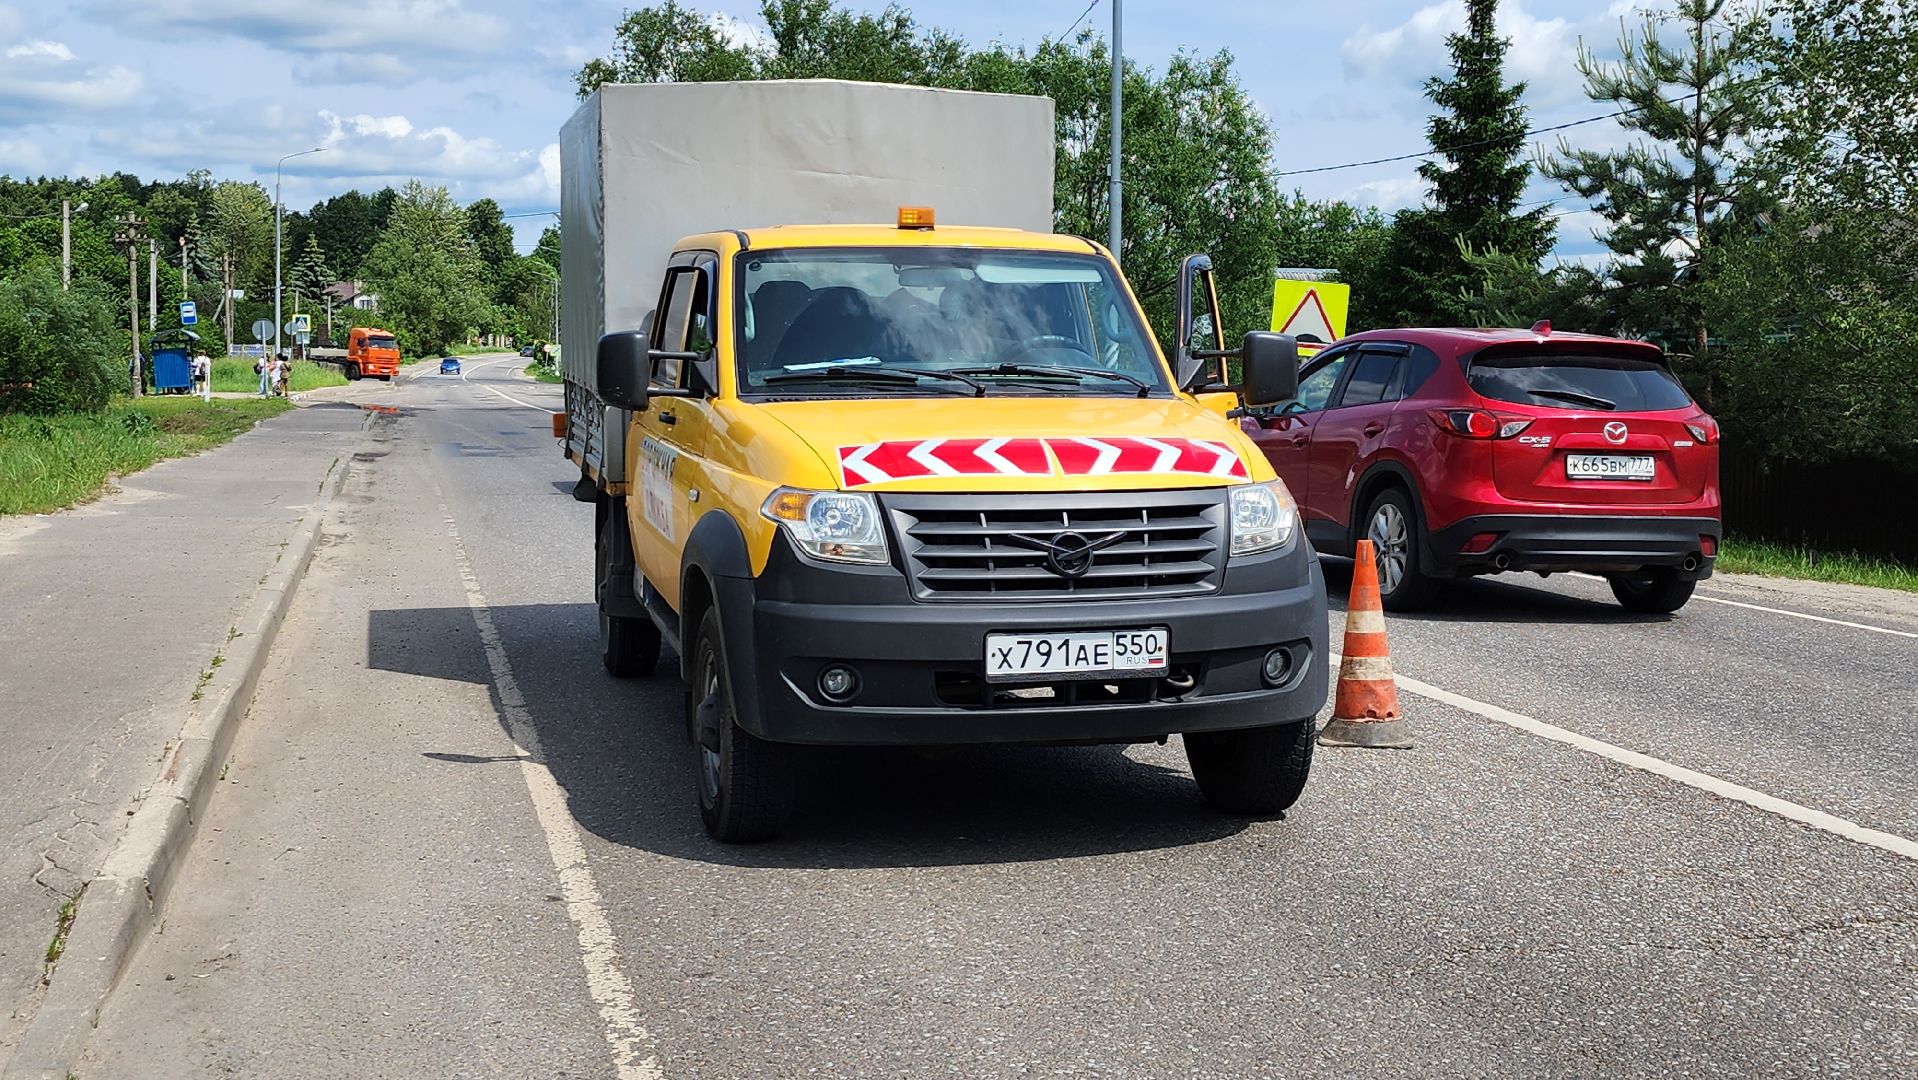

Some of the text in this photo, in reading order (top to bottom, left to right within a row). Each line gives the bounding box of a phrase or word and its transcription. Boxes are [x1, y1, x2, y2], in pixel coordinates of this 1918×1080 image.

[1519, 436, 1552, 444] CX-5
[1629, 457, 1650, 469] 777
[1115, 634, 1157, 656] 550
[1126, 656, 1148, 665] RUS
